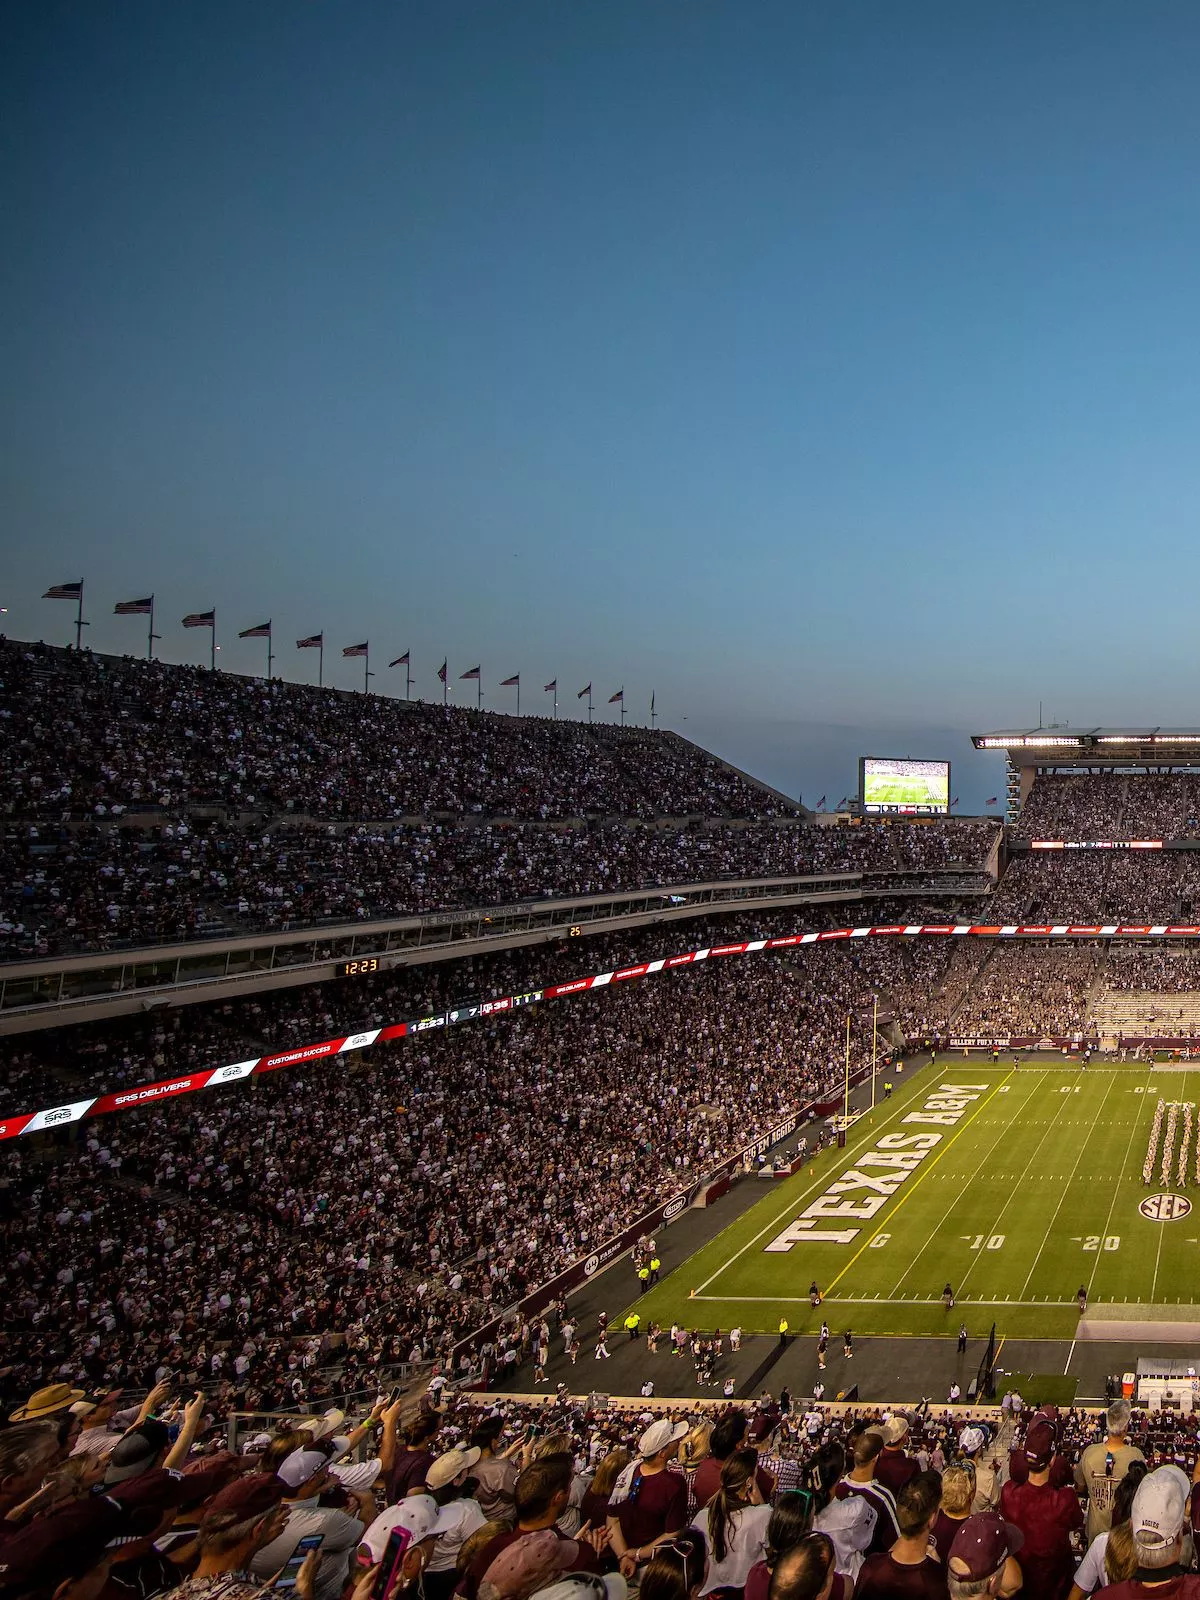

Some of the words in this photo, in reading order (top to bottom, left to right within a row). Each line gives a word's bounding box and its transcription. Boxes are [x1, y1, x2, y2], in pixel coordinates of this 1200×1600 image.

[345, 959, 377, 975] 12:23
[493, 999, 509, 1009] 35
[410, 1018, 444, 1032] 12:23
[267, 1051, 303, 1066] CUSTOMER
[303, 1045, 331, 1058] SUCCESS
[115, 1094, 139, 1105] SRS
[139, 1079, 192, 1100] DELIVERS
[1133, 1086, 1158, 1094] 20
[44, 1108, 72, 1123] SRS
[771, 1118, 796, 1146] AGGIES
[763, 1131, 944, 1252] TEXAS
[900, 1083, 991, 1126] A&M
[1142, 1195, 1188, 1219] SEC
[869, 1233, 891, 1248] G
[970, 1234, 1006, 1250] 10
[1082, 1235, 1121, 1251] 20
[600, 1242, 622, 1260] FARMS
[1141, 1519, 1160, 1530] AGGIES
